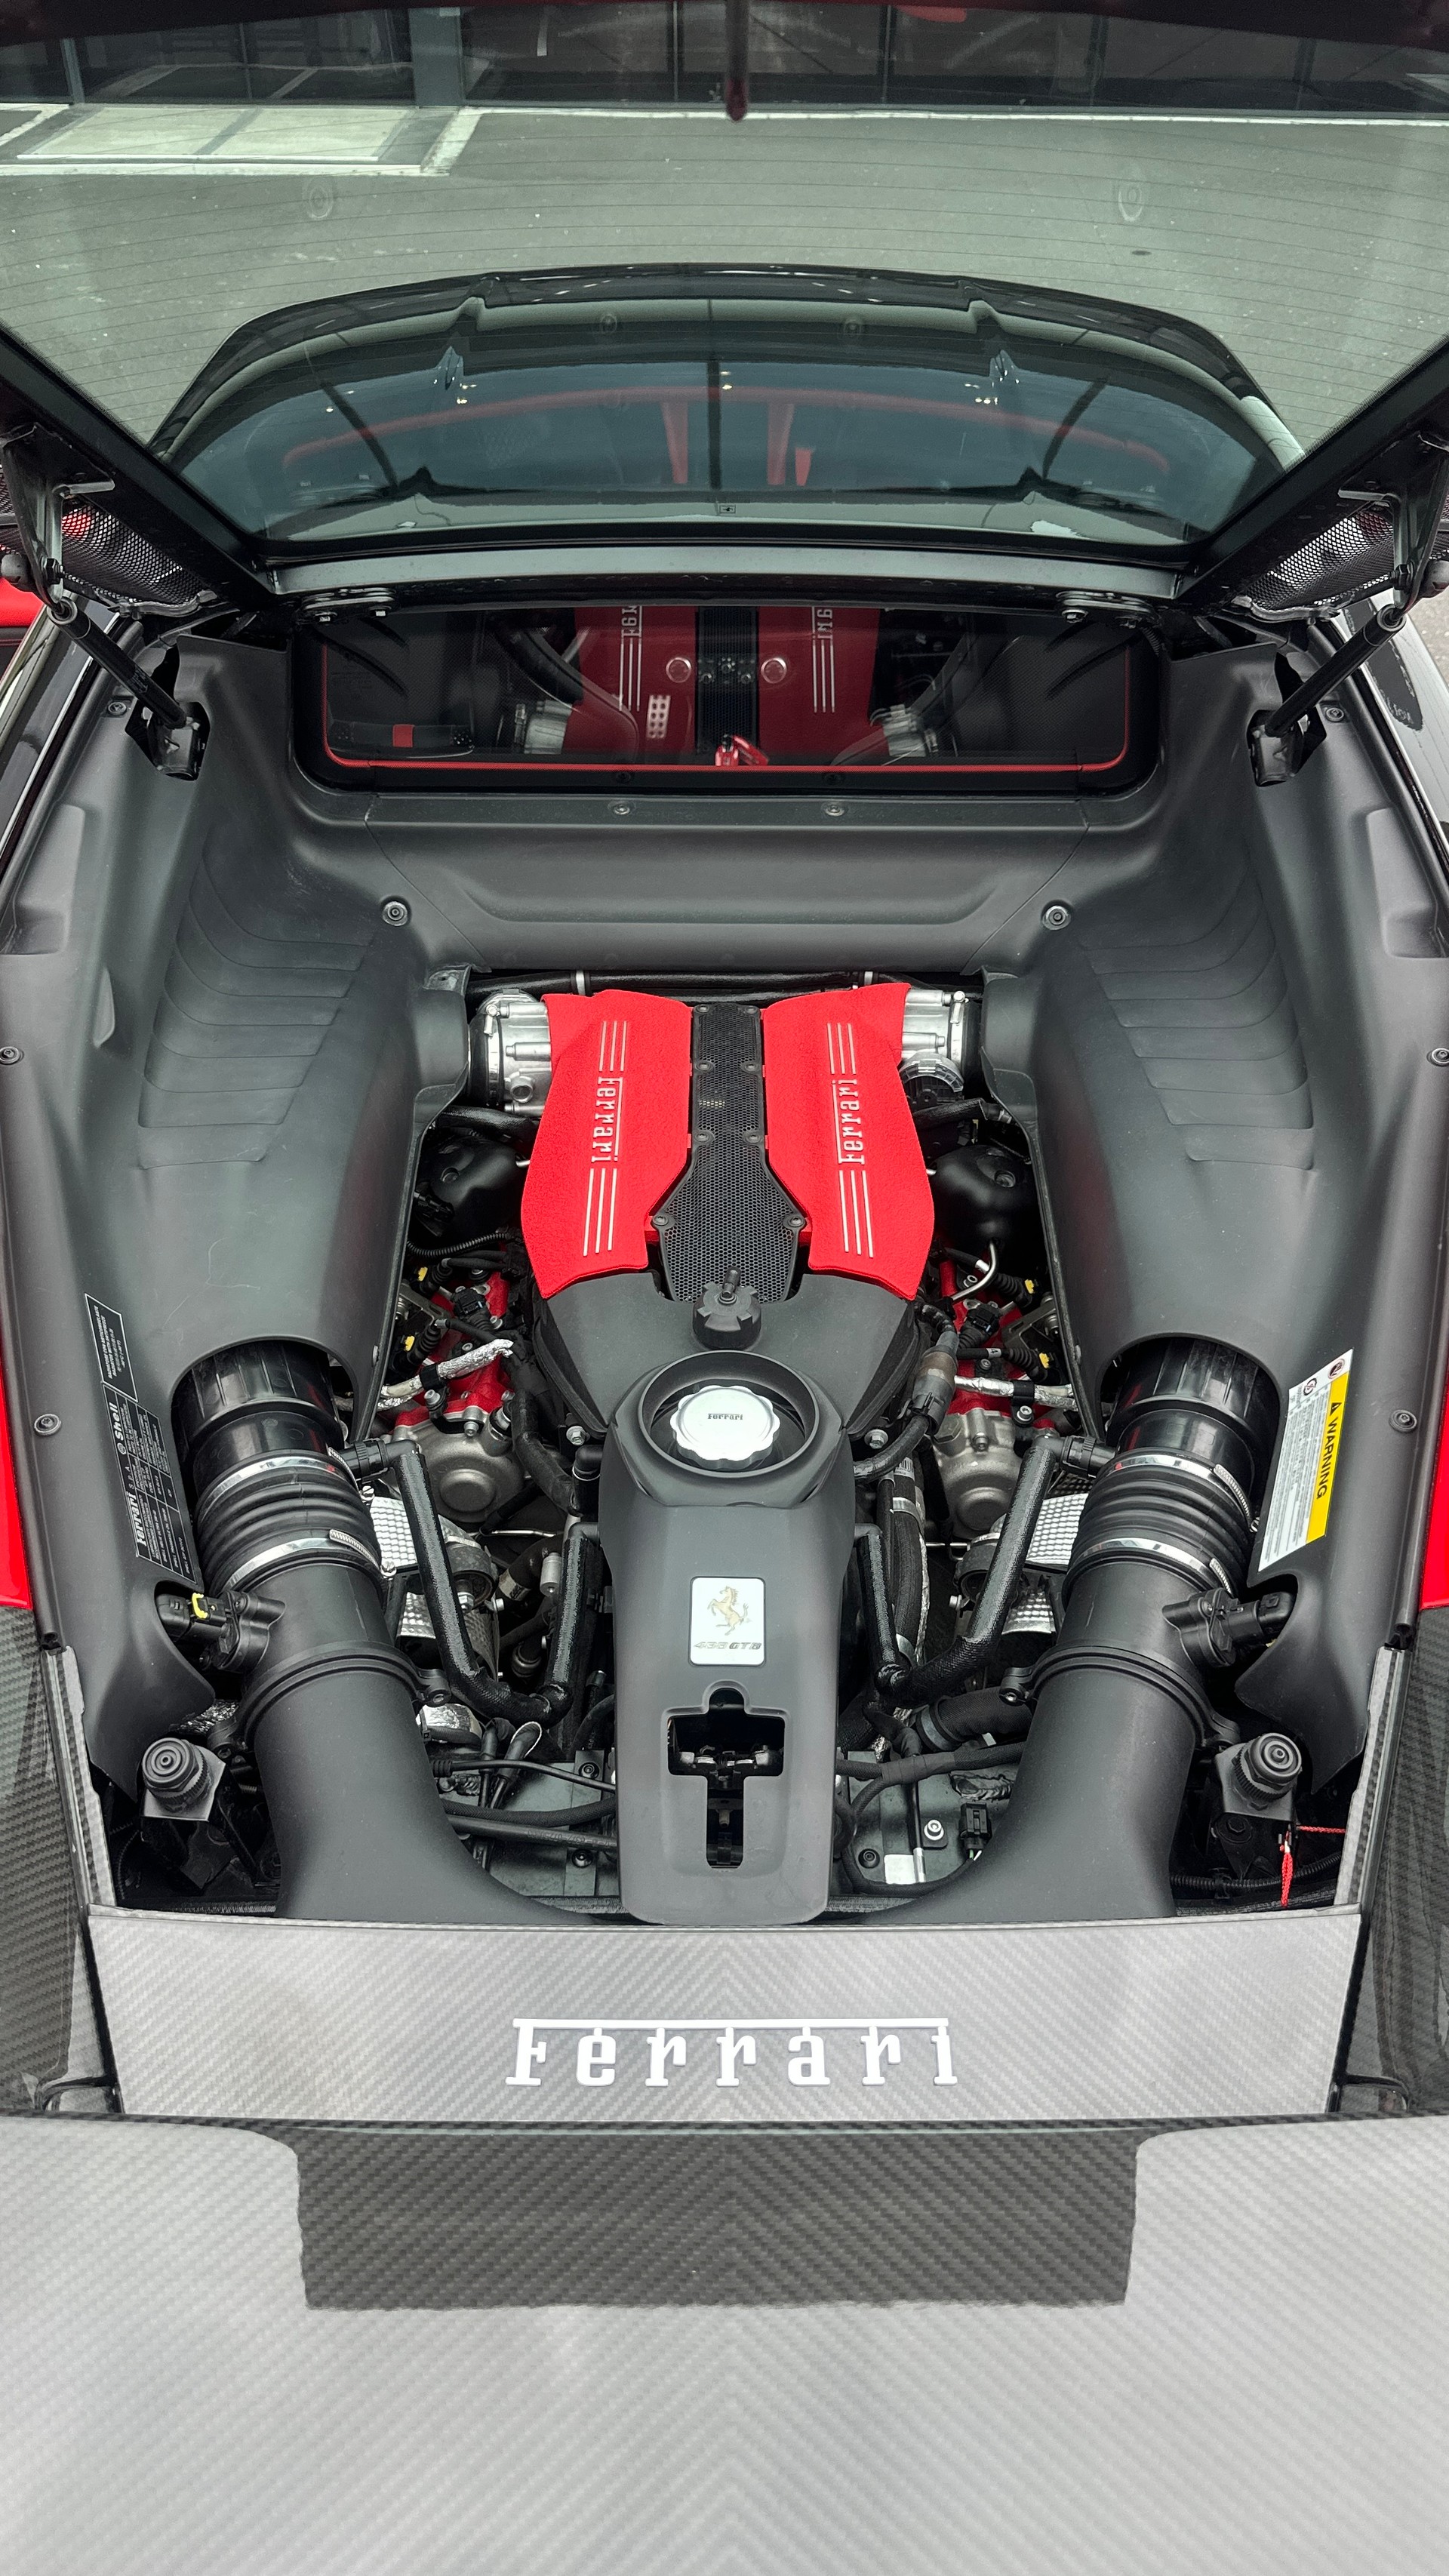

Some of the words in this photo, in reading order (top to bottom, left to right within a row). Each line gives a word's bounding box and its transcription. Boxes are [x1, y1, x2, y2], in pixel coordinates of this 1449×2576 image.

[591, 1077, 623, 1163] Ferrari
[831, 1079, 866, 1165] Ferrari
[109, 1402, 125, 1442] Shell
[1317, 1417, 1339, 1499] WARNING
[125, 1490, 147, 1547] Ferrari
[729, 1642, 762, 1650] GTB
[505, 2017, 958, 2086] Ferrari
